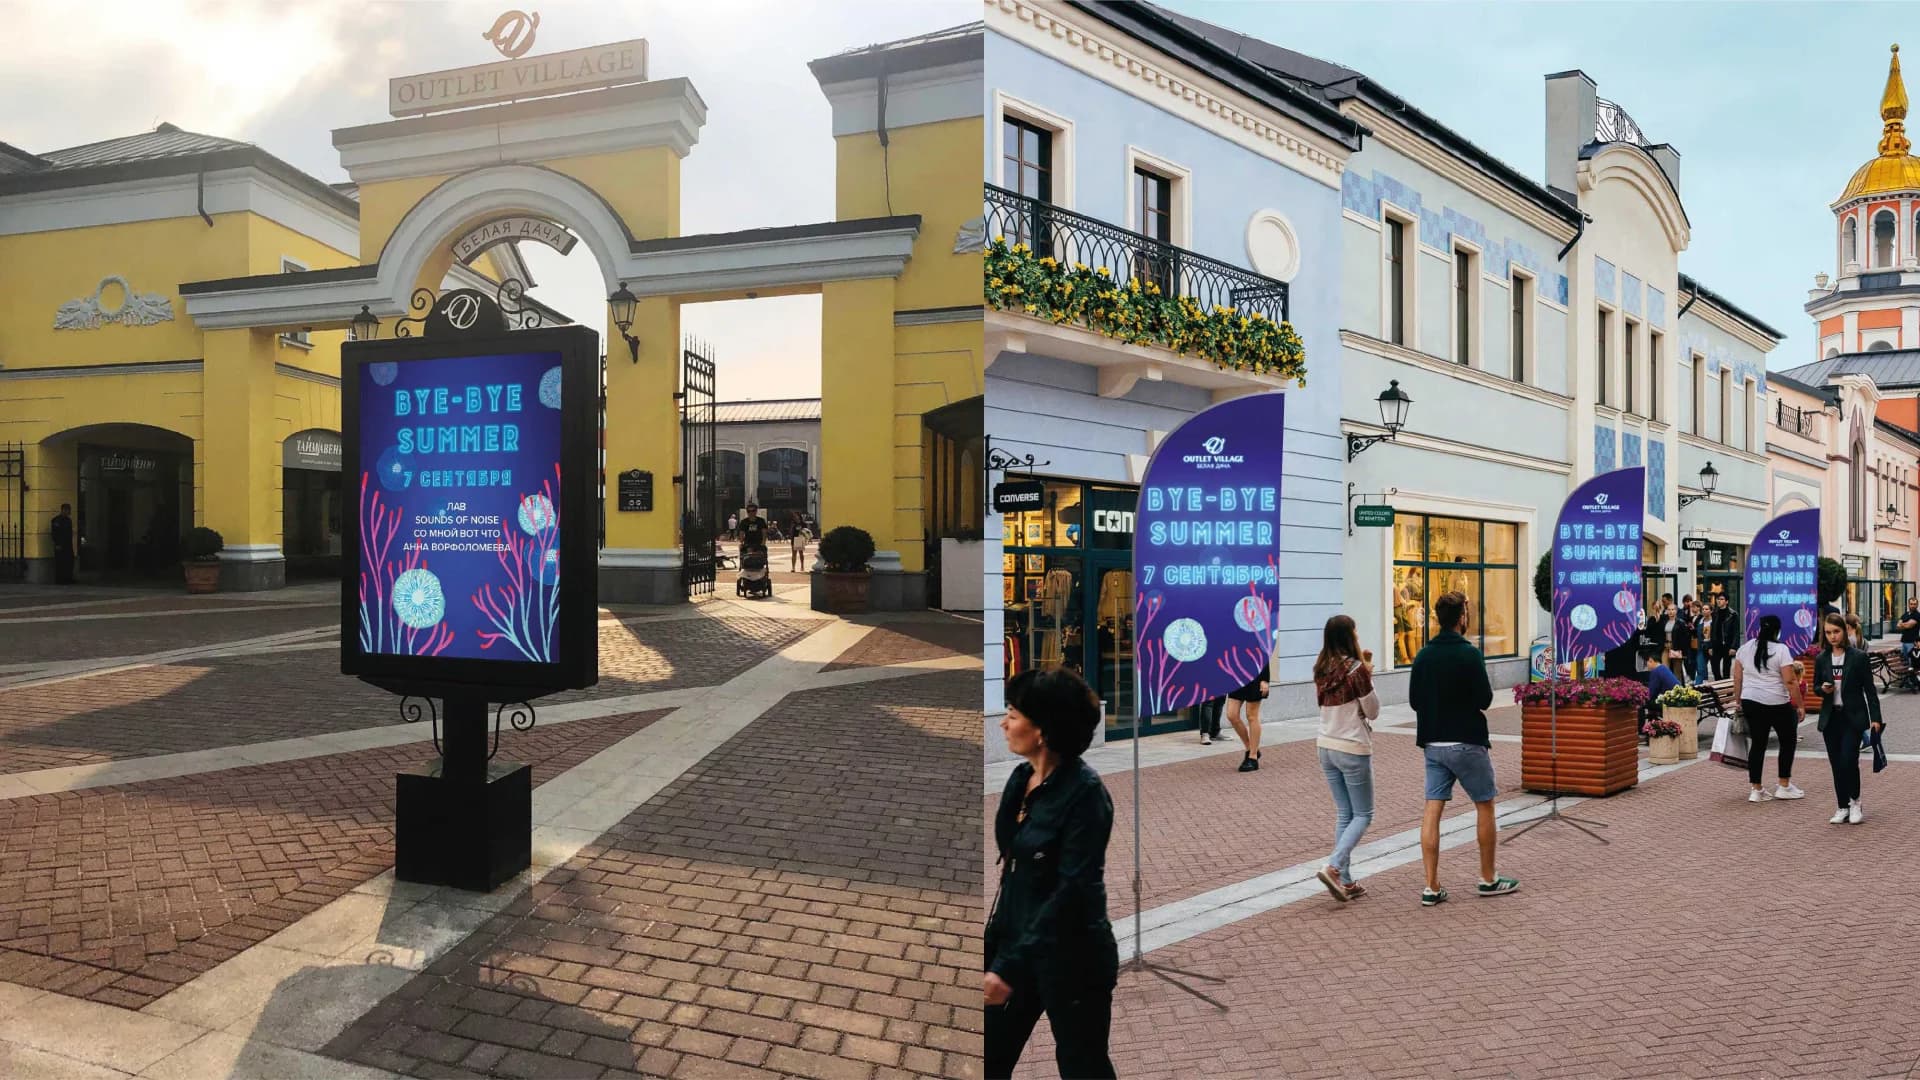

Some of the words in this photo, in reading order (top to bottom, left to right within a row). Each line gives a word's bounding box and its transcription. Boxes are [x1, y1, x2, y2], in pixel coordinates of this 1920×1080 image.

[398, 70, 505, 103] OUTLET
[512, 49, 635, 87] VILLAGE
[461, 221, 512, 253] БЕЛАЯ
[520, 221, 561, 246] ДАЧА
[394, 384, 523, 416] BYE-BYE
[397, 424, 520, 454] SUMMER
[1183, 455, 1212, 463] OUTLET
[1214, 455, 1244, 463] VILLAGE
[403, 471, 413, 488] 7
[419, 469, 513, 488] СЕНТЯБРЯ
[1000, 492, 1039, 503] CONVERSE
[1147, 487, 1276, 512] BYE-BYE
[447, 502, 467, 511] ЛАВ
[415, 515, 453, 524] SOUNDS
[456, 515, 468, 524] OF
[471, 515, 500, 524] NOISE
[1094, 509, 1136, 533] CON
[413, 529, 426, 538] СО
[429, 527, 458, 538] МНОЙ
[460, 529, 479, 538] ВОТ
[481, 529, 501, 538] ЧТО
[1150, 521, 1273, 545] SUMMER
[1560, 524, 1640, 540] BYE-BYE
[403, 543, 430, 551] АННА
[431, 542, 511, 552] ВОРФОЛОМЕЕВА
[1561, 544, 1638, 560] SUMMER
[1686, 540, 1706, 549] VANS
[1709, 550, 1722, 565] VANS
[1143, 565, 1156, 585] 7
[1163, 565, 1278, 585] СЕНТЯБРЯ
[1558, 571, 1566, 585] 7
[1751, 571, 1815, 585] SUMMER
